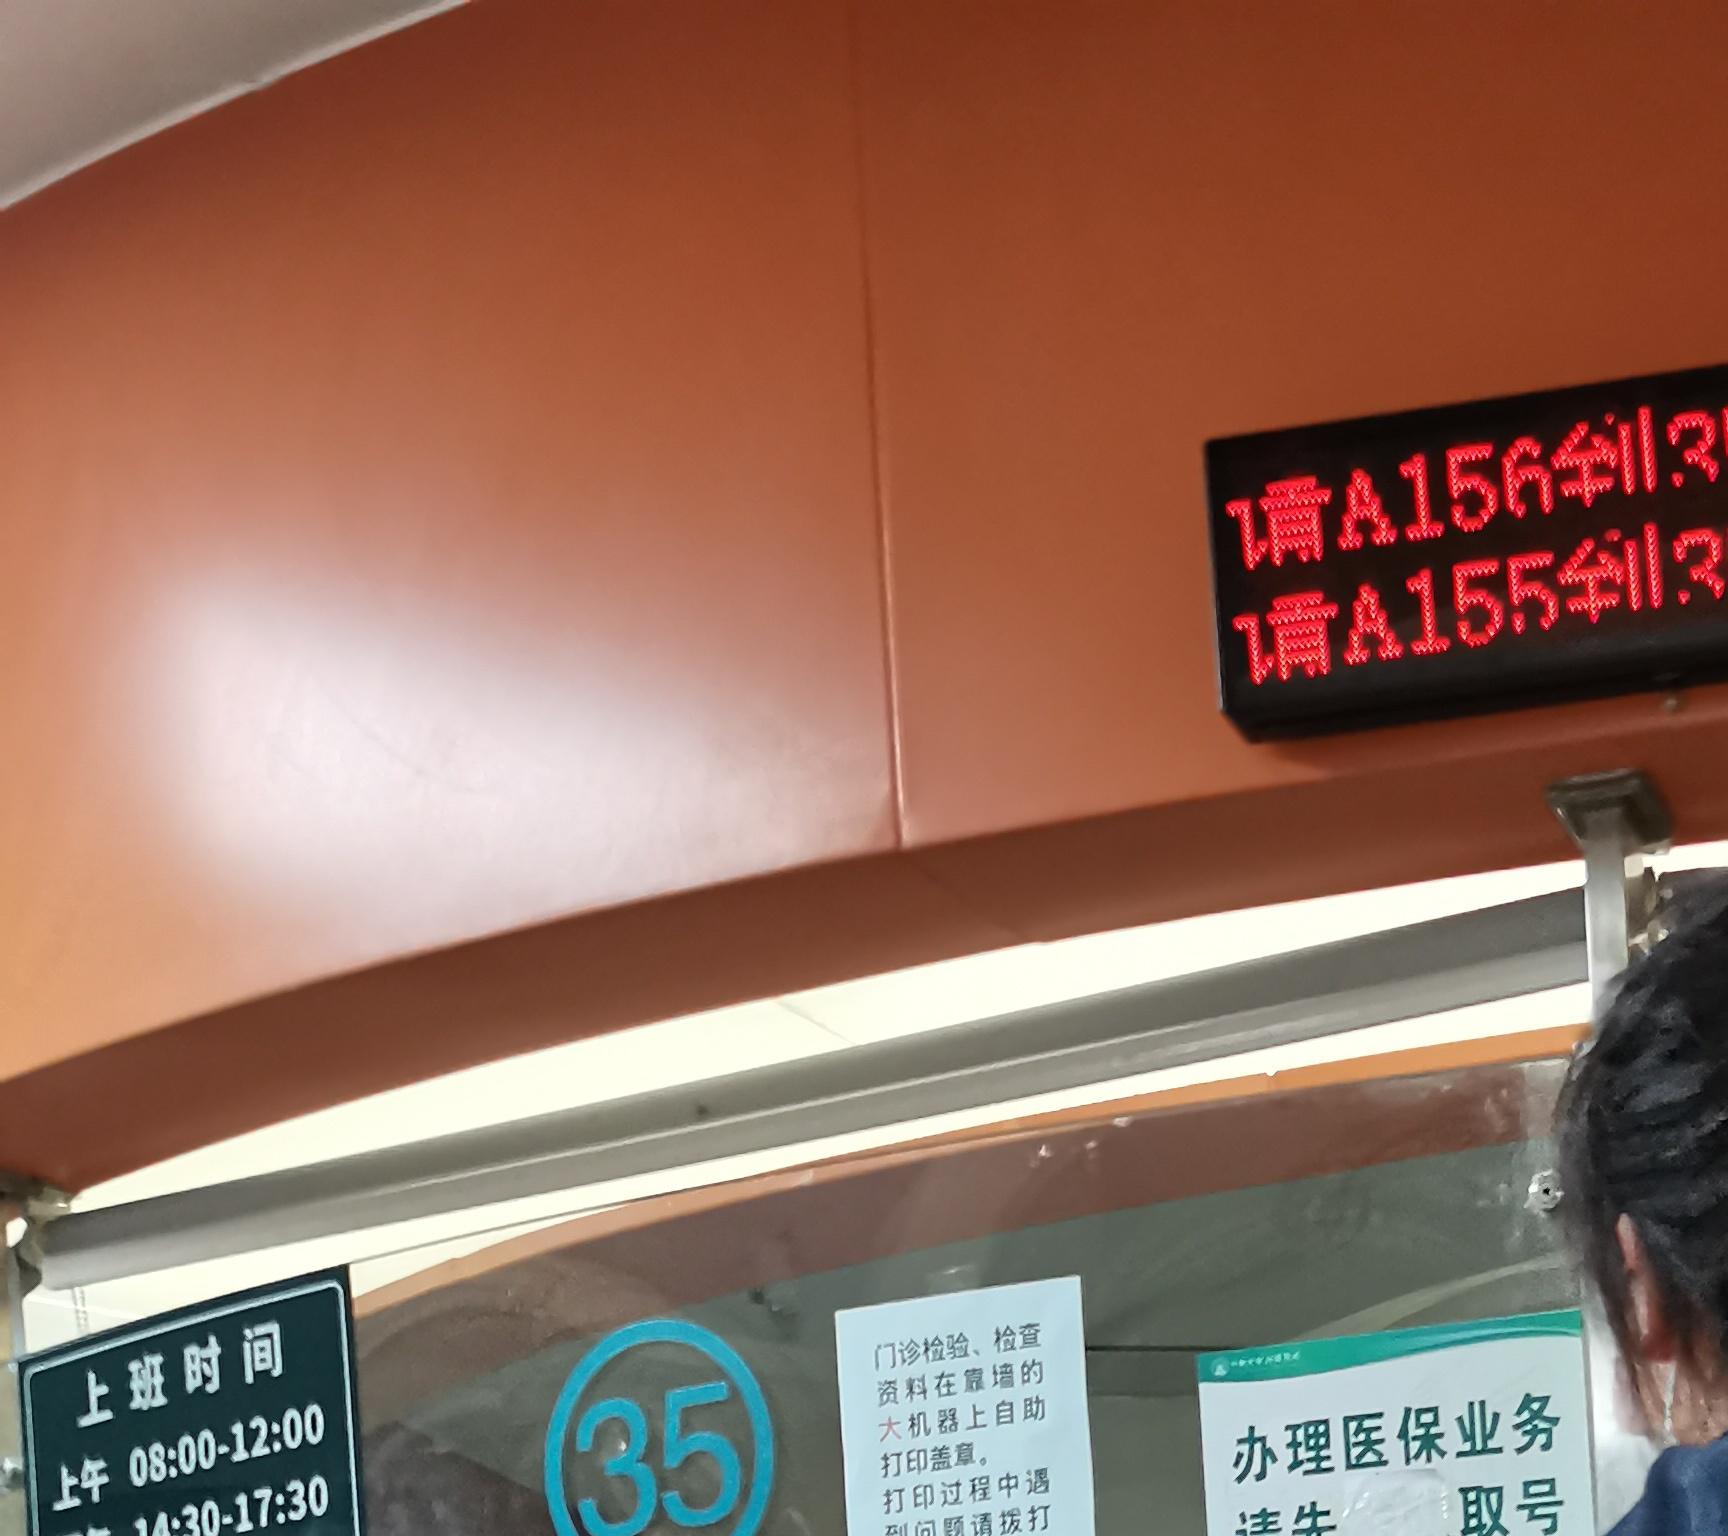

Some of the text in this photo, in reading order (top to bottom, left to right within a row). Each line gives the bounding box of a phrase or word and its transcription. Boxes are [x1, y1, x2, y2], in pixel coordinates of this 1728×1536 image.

[874, 1322, 1042, 1372] 门诊检验、检查
[76, 1319, 283, 1428] 上班时间
[877, 1359, 1045, 1408] 资料在靠墙的
[879, 1397, 1047, 1443] 大机器上自助
[1232, 1393, 1561, 1485] 办理医保业务
[52, 1403, 325, 1512] 上午 08:00-12:00
[881, 1442, 987, 1479] 打印盖章。
[883, 1467, 1051, 1516] 打印过程中遇
